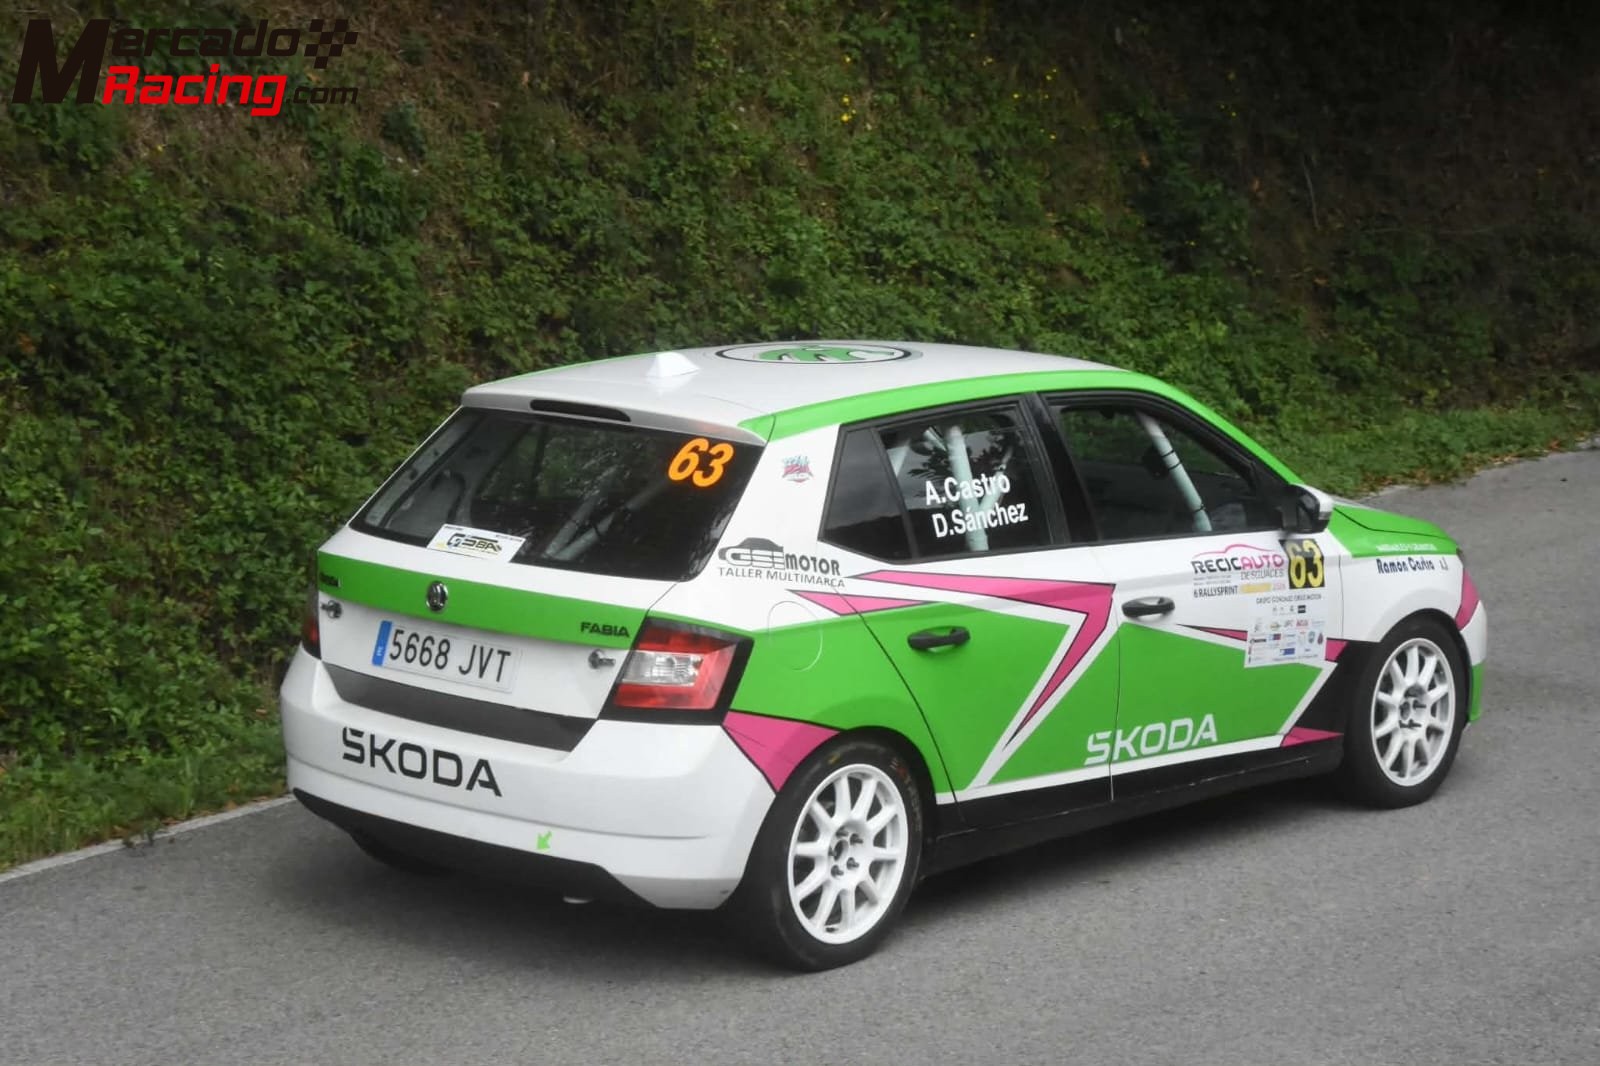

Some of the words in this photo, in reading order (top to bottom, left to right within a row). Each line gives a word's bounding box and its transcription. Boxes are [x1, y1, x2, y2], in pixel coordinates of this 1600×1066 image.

[668, 438, 734, 488] 63
[925, 473, 1010, 506] A.Castro
[932, 502, 1029, 538] D.Sánchez
[719, 567, 763, 579] TALLER
[766, 570, 846, 588] MULTIMARCA
[1191, 554, 1285, 574] RECICAUTO
[1285, 539, 1324, 588] 63
[1199, 585, 1238, 598] RALLYSPRINT
[580, 622, 630, 638] FABIA
[390, 629, 451, 670] 5668
[458, 644, 511, 683] JVT
